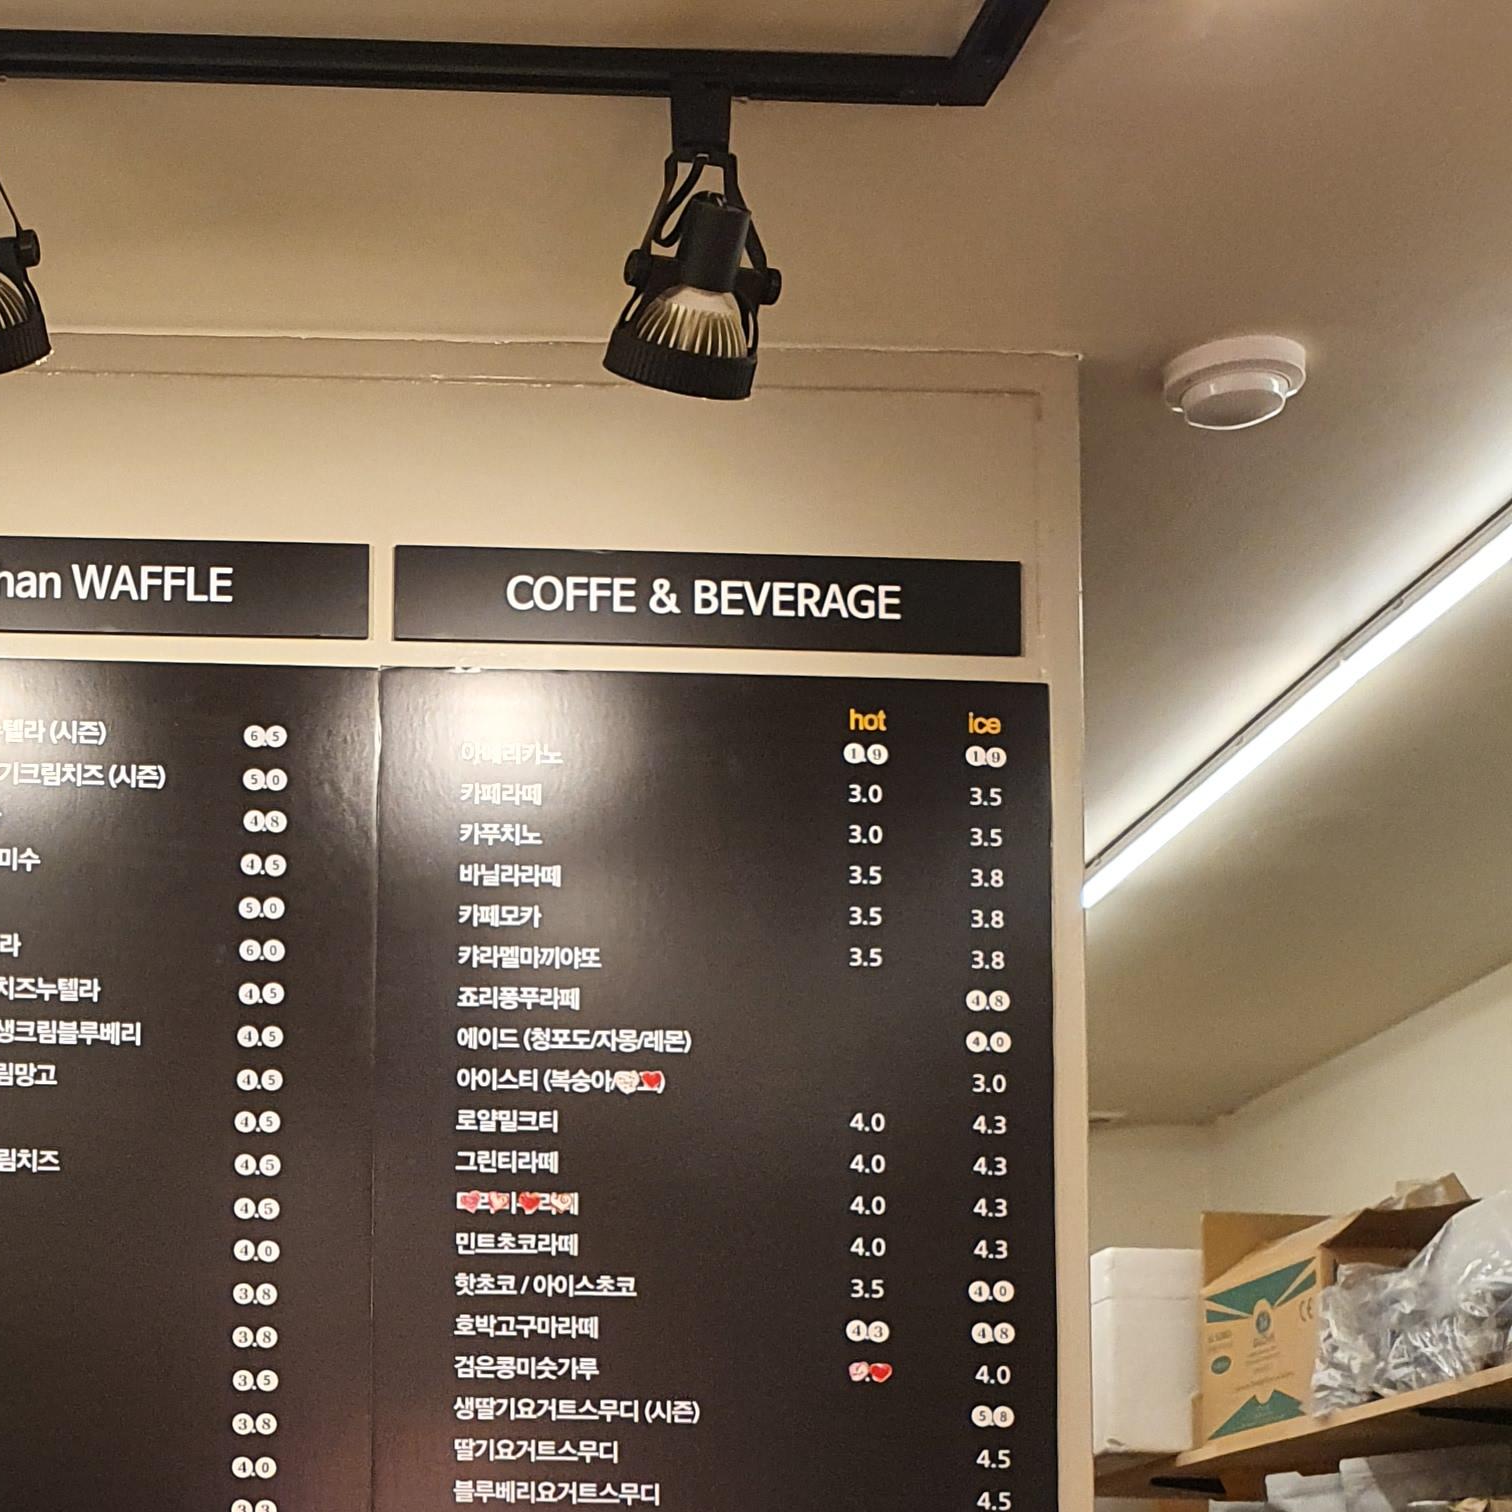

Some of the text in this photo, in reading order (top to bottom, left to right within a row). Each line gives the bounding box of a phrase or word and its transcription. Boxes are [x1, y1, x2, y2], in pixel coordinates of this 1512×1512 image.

[71, 563, 234, 603] WAFFLE
[506, 574, 902, 620] COFFE & BEVERAGE
[49, 719, 107, 746] (시즌)
[849, 708, 1002, 735] hot ice
[108, 764, 166, 790] (시즌)
[460, 782, 542, 806] 카페라떼
[848, 784, 1002, 807] 3.0 3.5
[459, 822, 543, 846] 카푸치노
[459, 863, 562, 888] 바닐라라떼
[848, 865, 1004, 888] 3.5 3.8
[458, 903, 543, 929] 카페모카
[456, 986, 580, 1011] 죠리퐁푸라페
[456, 1026, 692, 1054] 에이드 (청포도/자몽/레몬)
[456, 1067, 539, 1092] 아이스티
[972, 1073, 1007, 1093] 3.0
[455, 1109, 559, 1133] 로얄밀크티
[849, 1112, 1007, 1135] 4.0 4.3
[454, 1149, 559, 1174] 그린티라떼
[455, 1232, 579, 1257] 민트초코라떼
[454, 1272, 638, 1298] 핫초코 아이스초코
[453, 1314, 599, 1340] 호박고구마라떼
[454, 1355, 600, 1381] 검은콩미숫가루
[975, 1365, 1011, 1385] 4.0
[453, 1396, 701, 1424] 생딸기요거트스무디 (시즌)
[454, 1438, 618, 1464] 딸기요거트스무디
[976, 1449, 1011, 1469] 4.5
[452, 1479, 660, 1506] 블루베리요거트스무디
